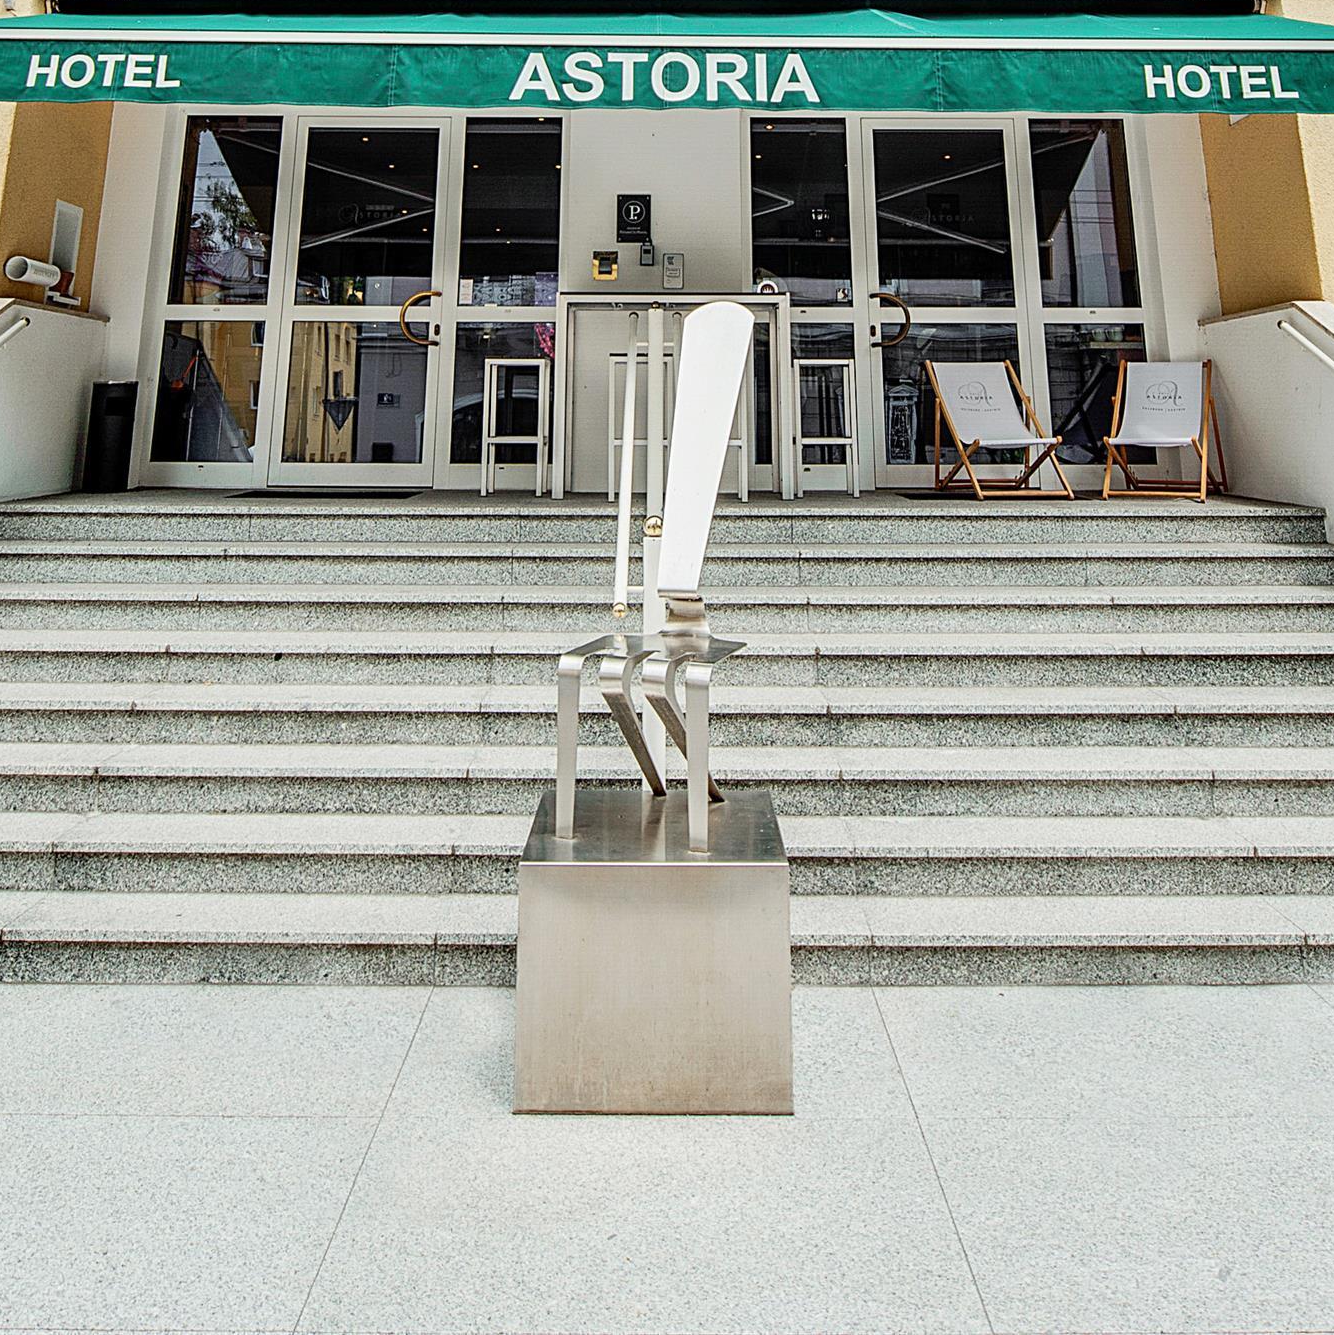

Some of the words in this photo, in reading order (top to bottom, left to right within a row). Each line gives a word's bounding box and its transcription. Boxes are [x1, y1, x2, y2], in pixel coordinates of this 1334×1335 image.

[26, 54, 180, 88] HOTEL
[509, 52, 820, 103] ASTORIA
[1144, 64, 1299, 99] HOTEL
